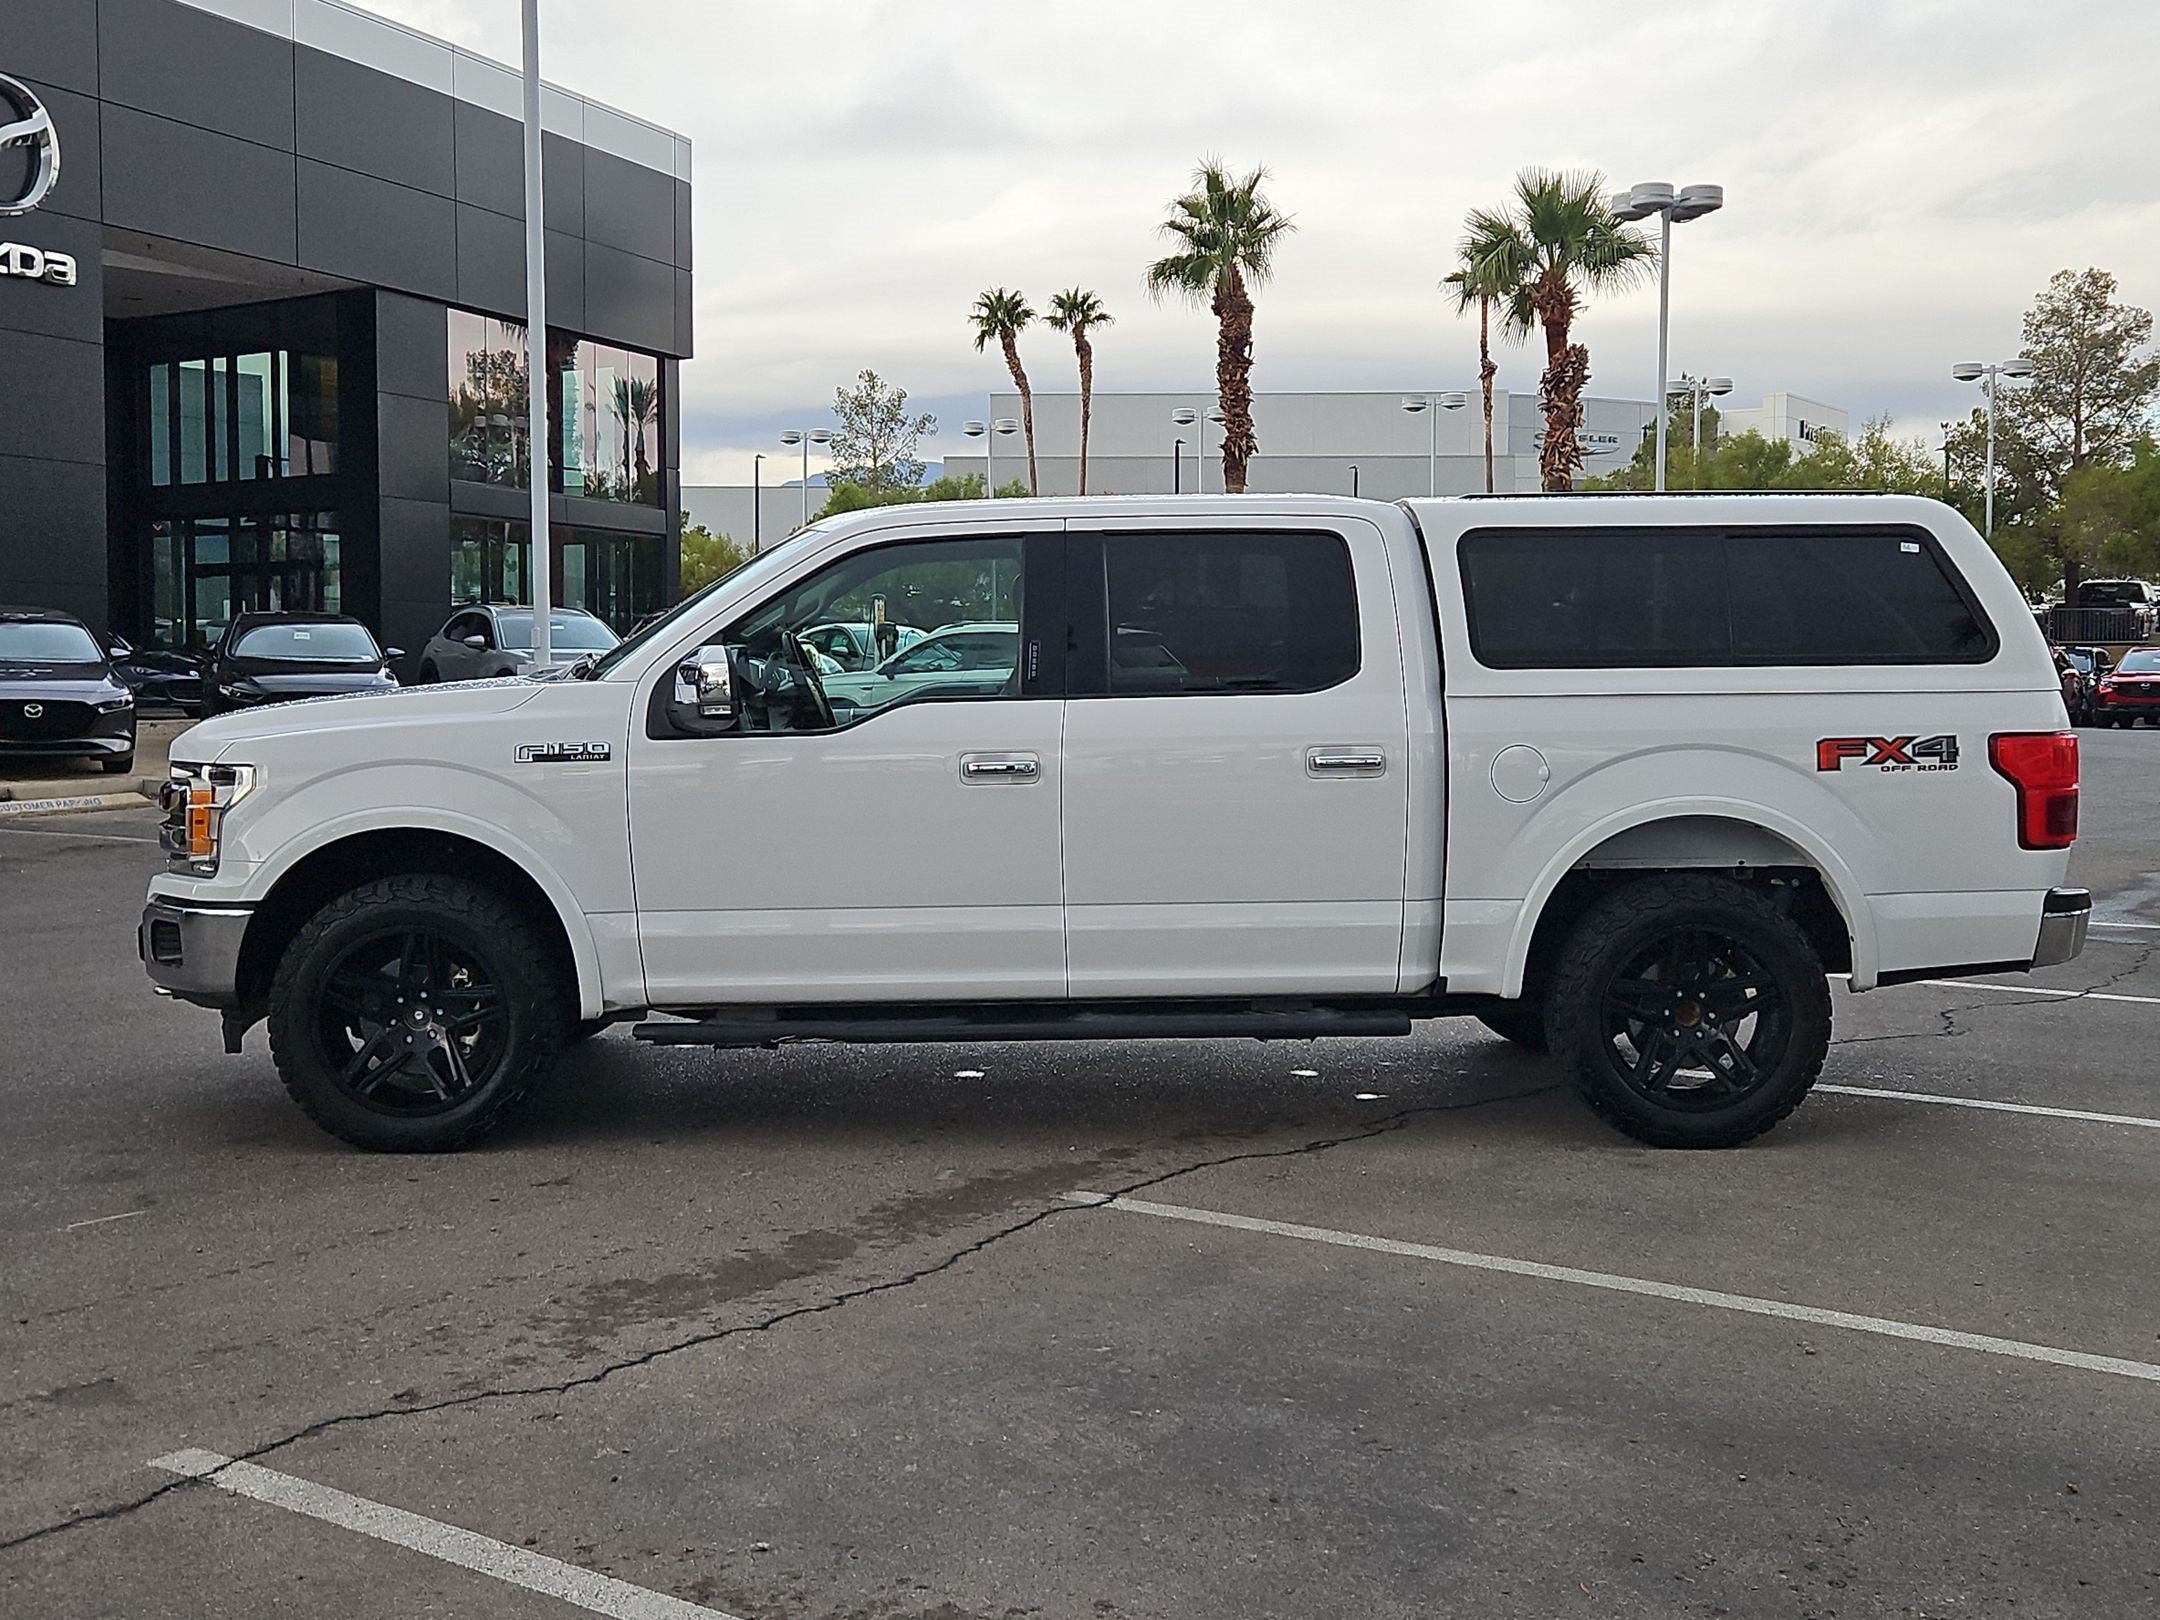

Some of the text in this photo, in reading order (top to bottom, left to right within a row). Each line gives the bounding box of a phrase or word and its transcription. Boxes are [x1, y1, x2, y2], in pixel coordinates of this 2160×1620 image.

[1816, 735, 1960, 771] FX4
[1880, 764, 1959, 773] OFF ROAD
